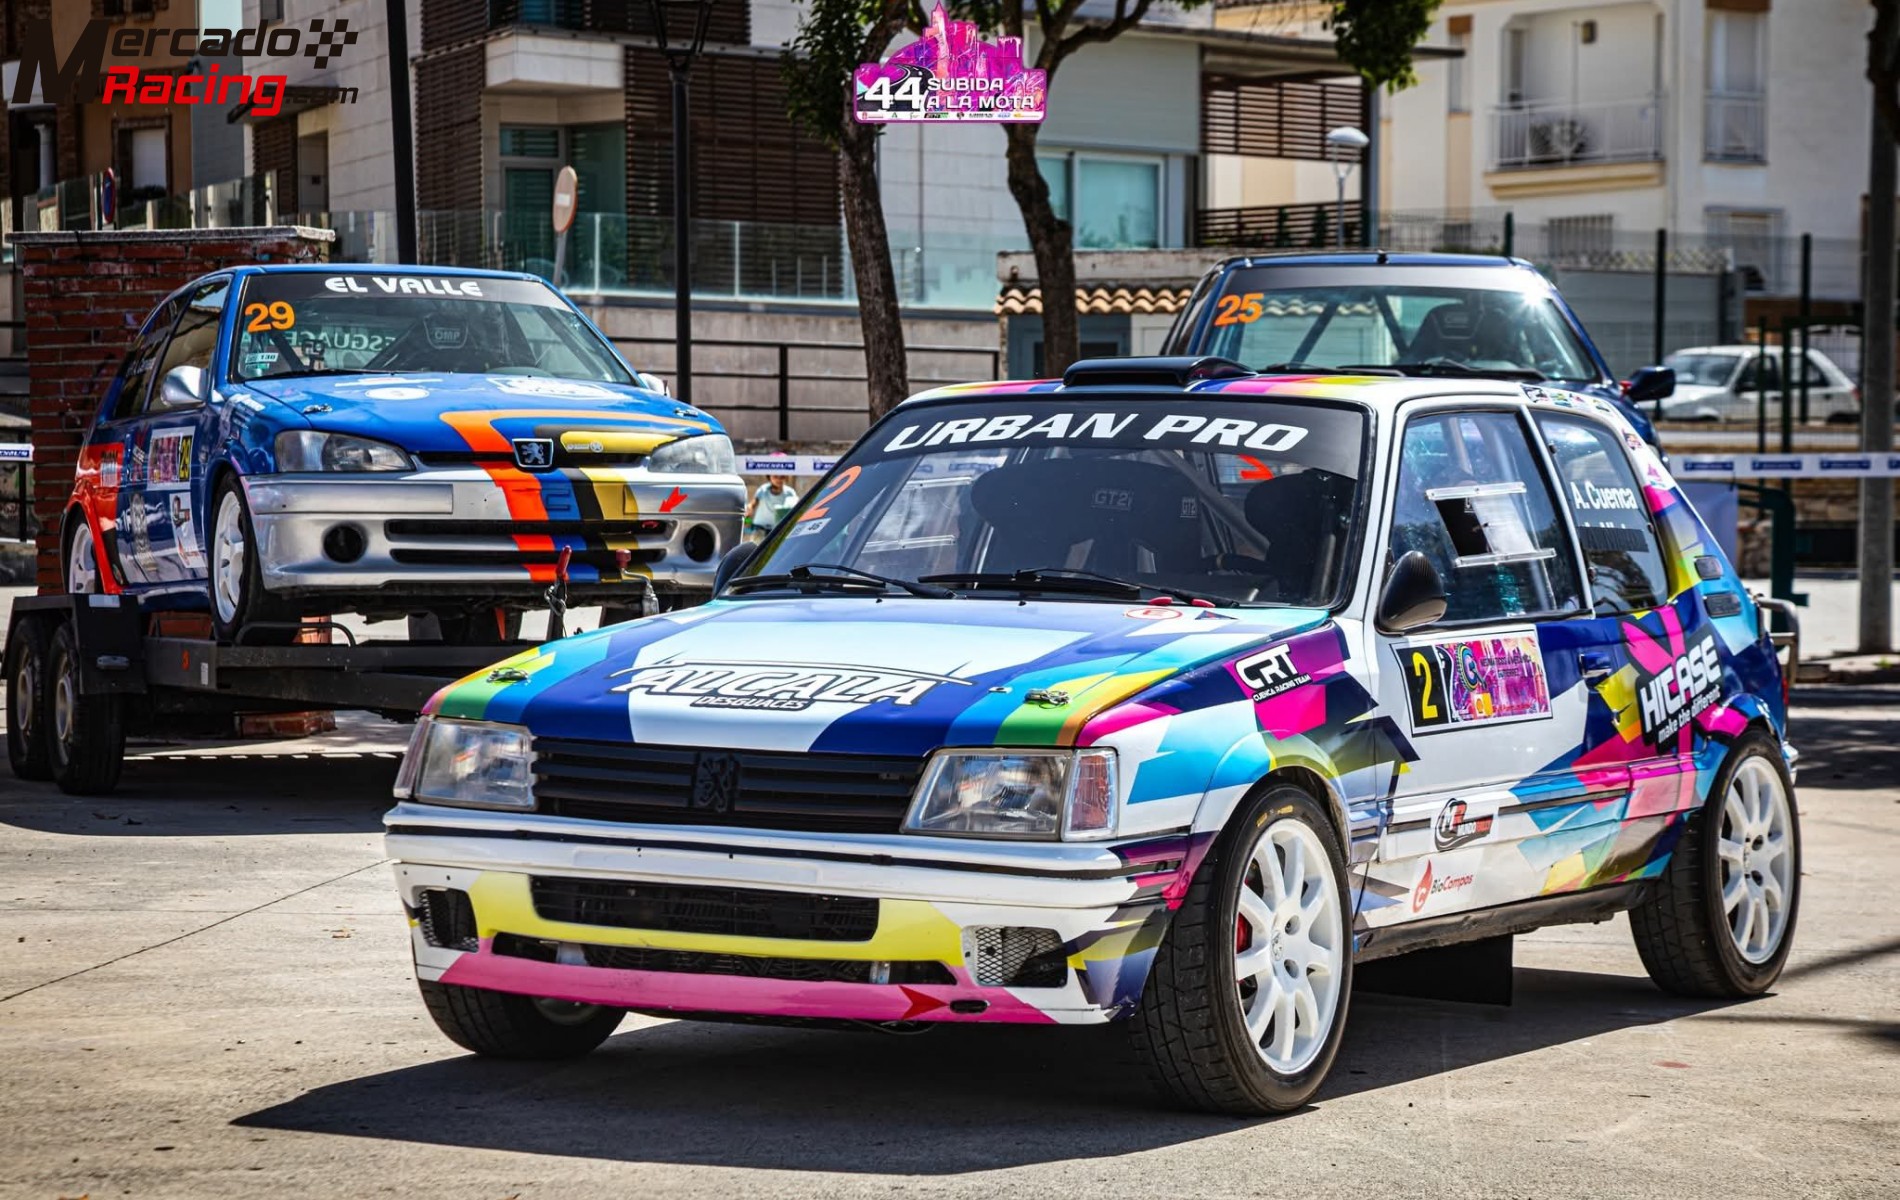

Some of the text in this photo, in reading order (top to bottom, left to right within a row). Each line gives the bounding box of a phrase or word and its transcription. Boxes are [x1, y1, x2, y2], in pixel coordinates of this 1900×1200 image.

[325, 277, 483, 297] EL VALLE
[244, 301, 296, 333] 29
[1214, 293, 1264, 326] 25
[883, 413, 1309, 452] URBAN PRO
[798, 466, 862, 522] 2
[1235, 643, 1298, 689] CRT
[1293, 674, 1312, 686] TEAM
[1641, 635, 1721, 733] HICASE
[611, 668, 938, 707] ALCALA
[700, 696, 809, 711] DESGUACES
[1412, 651, 1438, 719] 2
[1658, 718, 1678, 743] make
[1678, 708, 1691, 728] the
